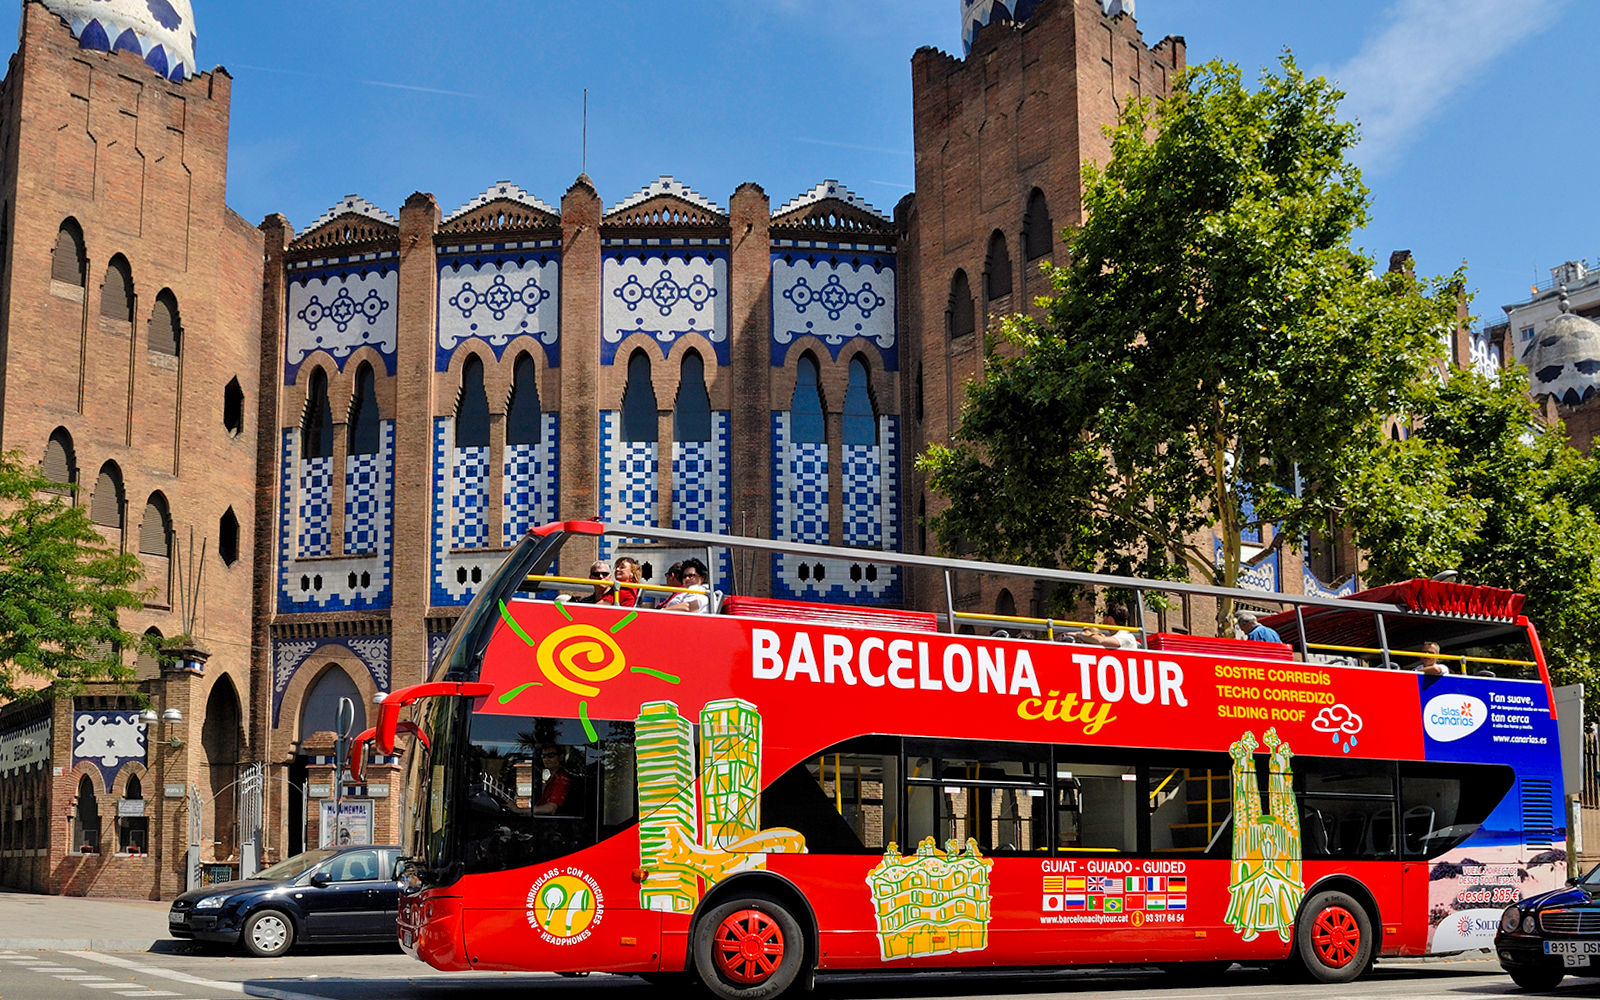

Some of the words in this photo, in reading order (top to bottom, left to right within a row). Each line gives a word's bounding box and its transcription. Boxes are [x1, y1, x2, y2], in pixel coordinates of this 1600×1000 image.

[751, 628, 1041, 697] BARCELONA
[1072, 653, 1188, 708] TOUR
[1214, 665, 1265, 680] SOSTRE
[1267, 669, 1331, 685] CORREDÍS
[1215, 684, 1260, 700] TECHO
[1262, 688, 1335, 705] CORREDIZO
[1488, 691, 1506, 702] Tan
[1506, 695, 1534, 706] suave,
[1016, 689, 1117, 735] city
[1217, 704, 1268, 720] SLIDING
[1270, 707, 1306, 722] ROOF
[1441, 706, 1461, 716] Islas
[1430, 714, 1474, 727] Canarias
[1491, 713, 1506, 723] tan
[1507, 715, 1530, 724] cerca
[1492, 734, 1548, 745] www.canarias.es
[566, 866, 584, 878] CON
[1041, 860, 1077, 873] GUIAT
[1087, 860, 1133, 873] GUIADO
[1143, 861, 1186, 874] GUIDED
[526, 867, 560, 909] AURICULARS
[1458, 888, 1491, 902] desde
[582, 874, 605, 926] AURICULARES
[526, 910, 539, 929] AMB
[1040, 913, 1129, 925] www.barcelonacitytour.cat
[1145, 913, 1154, 923] 93
[1154, 913, 1166, 923] 317
[1167, 913, 1176, 923] 64
[1176, 913, 1185, 923] 54
[1475, 918, 1500, 931] SOLTO
[540, 929, 592, 946] HEADPHONES
[1551, 942, 1577, 953] 8315
